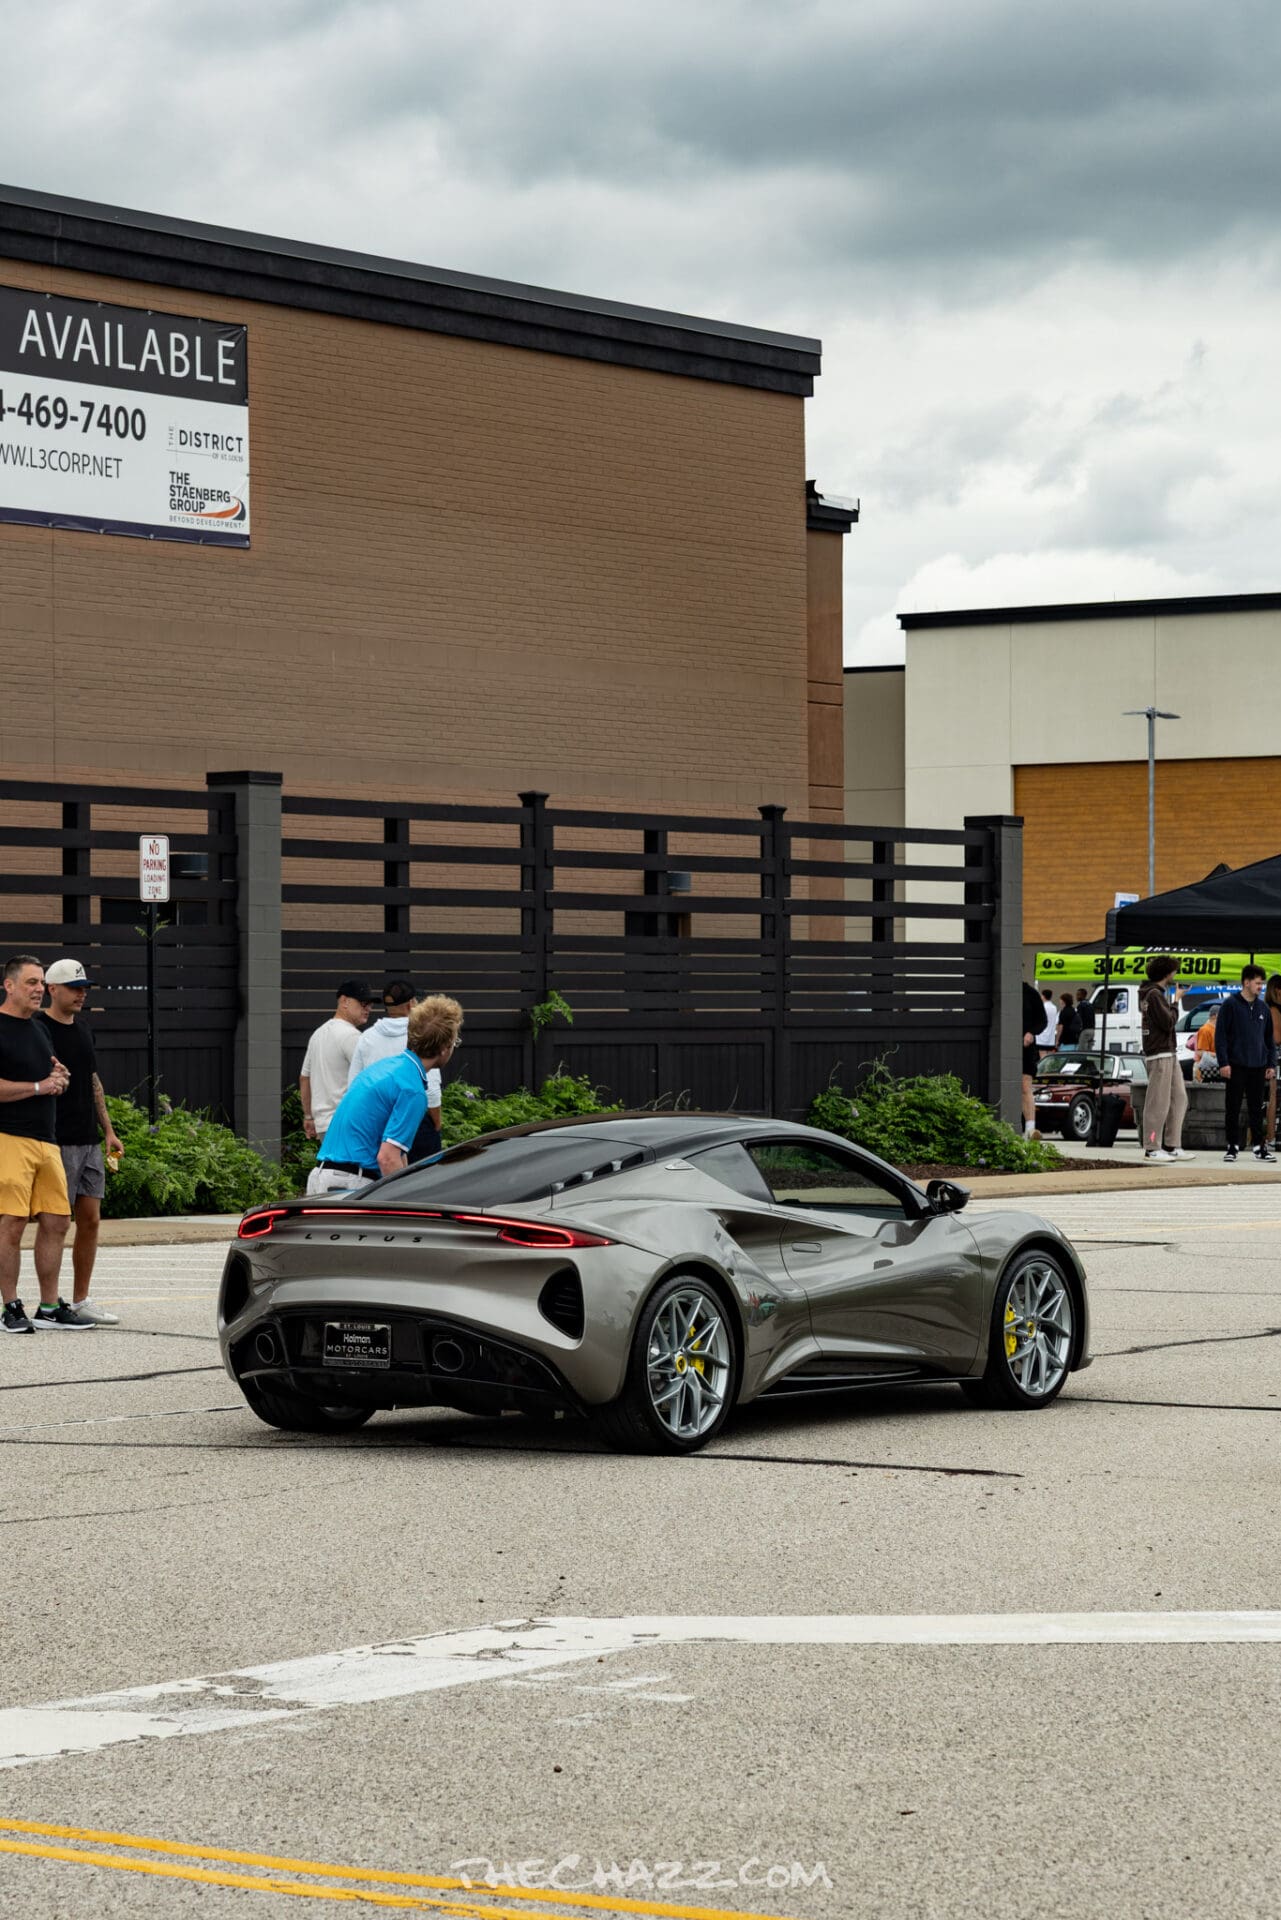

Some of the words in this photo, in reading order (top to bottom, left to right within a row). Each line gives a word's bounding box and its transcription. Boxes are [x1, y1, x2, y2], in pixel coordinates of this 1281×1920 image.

[19, 309, 236, 385] AVAILABLE
[179, 429, 243, 453] DISTRICT
[169, 471, 190, 485] THE
[169, 484, 231, 503] STAENBERG
[169, 498, 206, 513] GROUP
[169, 515, 195, 524] BEYOND
[196, 517, 241, 528] DEVELOPMENT
[149, 843, 160, 856] NO
[143, 859, 167, 871] PARKING
[144, 874, 166, 883] LOADING
[148, 886, 162, 895] ZONE
[305, 1233, 423, 1243] LOTUS
[326, 1345, 388, 1355] MOTORCARS
